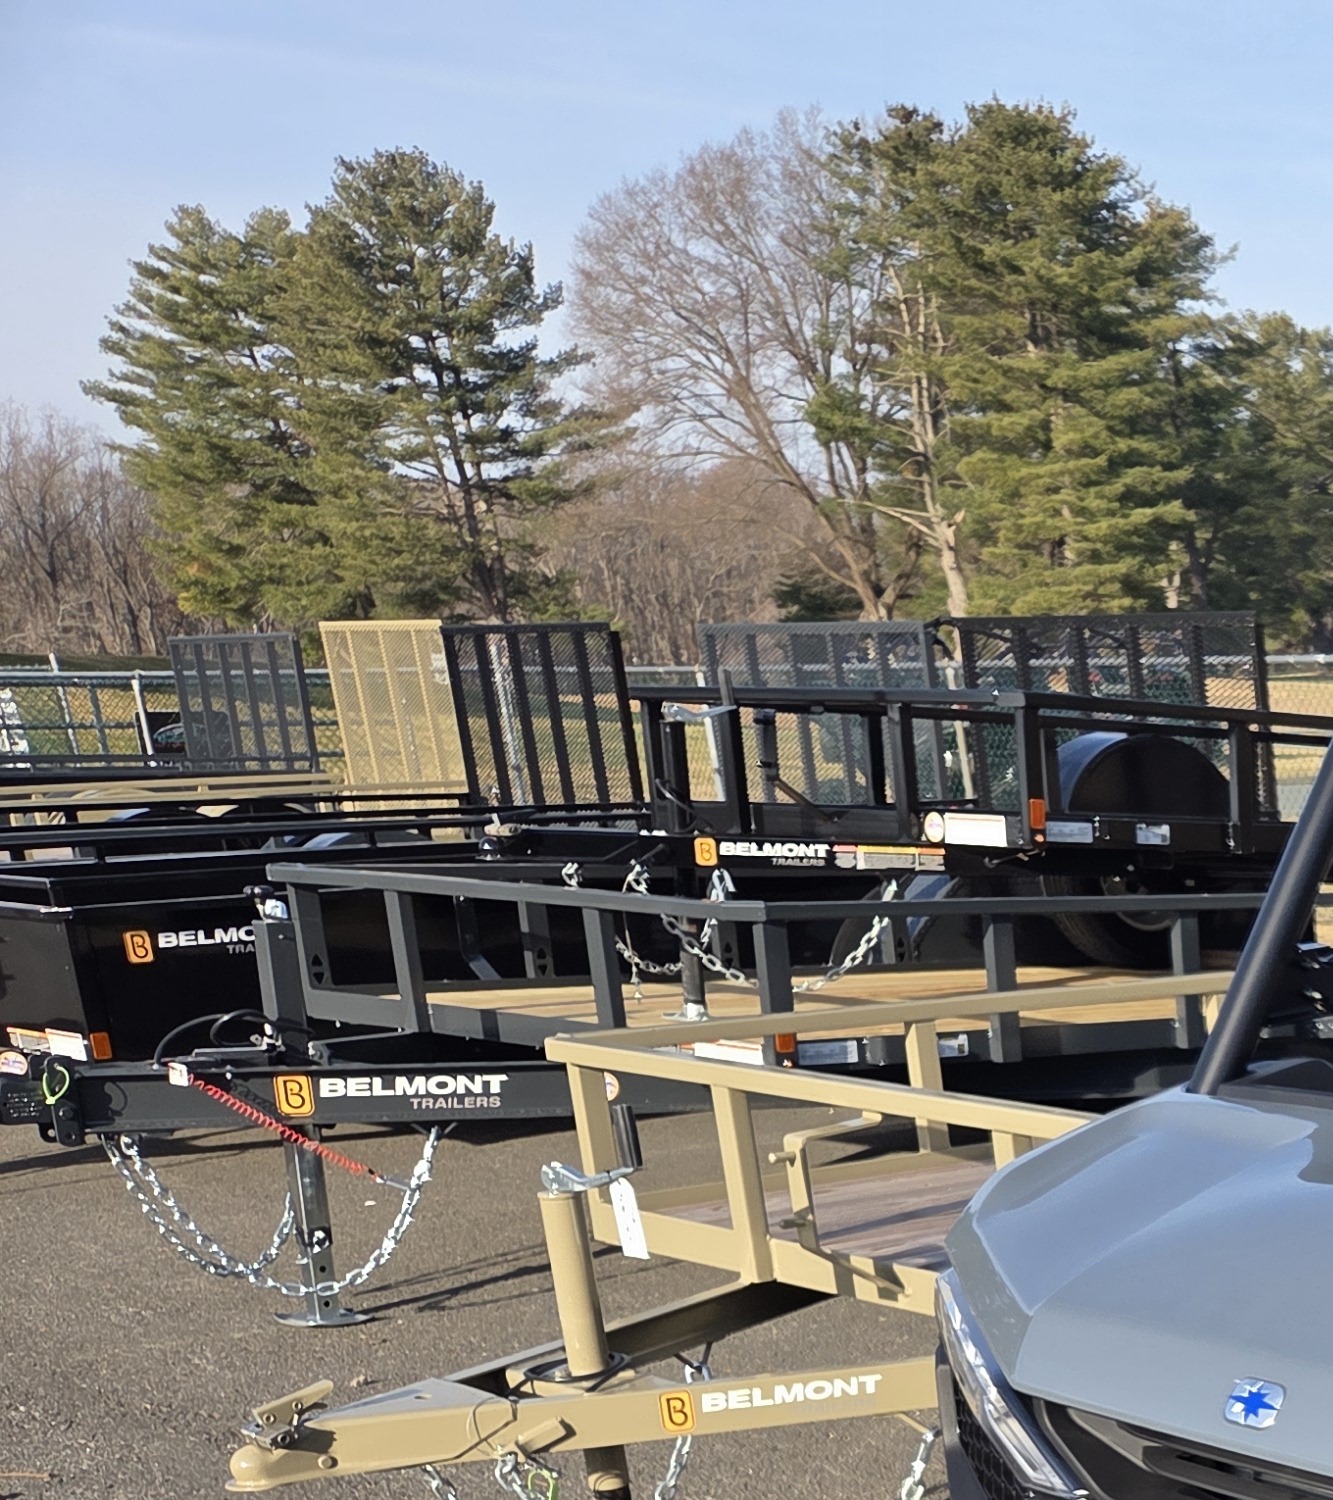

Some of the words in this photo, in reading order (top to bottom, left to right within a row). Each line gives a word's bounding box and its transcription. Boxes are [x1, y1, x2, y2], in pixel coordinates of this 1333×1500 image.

[719, 841, 831, 858] BELMONT
[772, 857, 826, 867] TRAILERS
[158, 925, 255, 948] BELMO
[319, 1074, 509, 1098] BELMONT
[410, 1096, 501, 1110] TRAILERS
[701, 1374, 883, 1413] BELMONT
